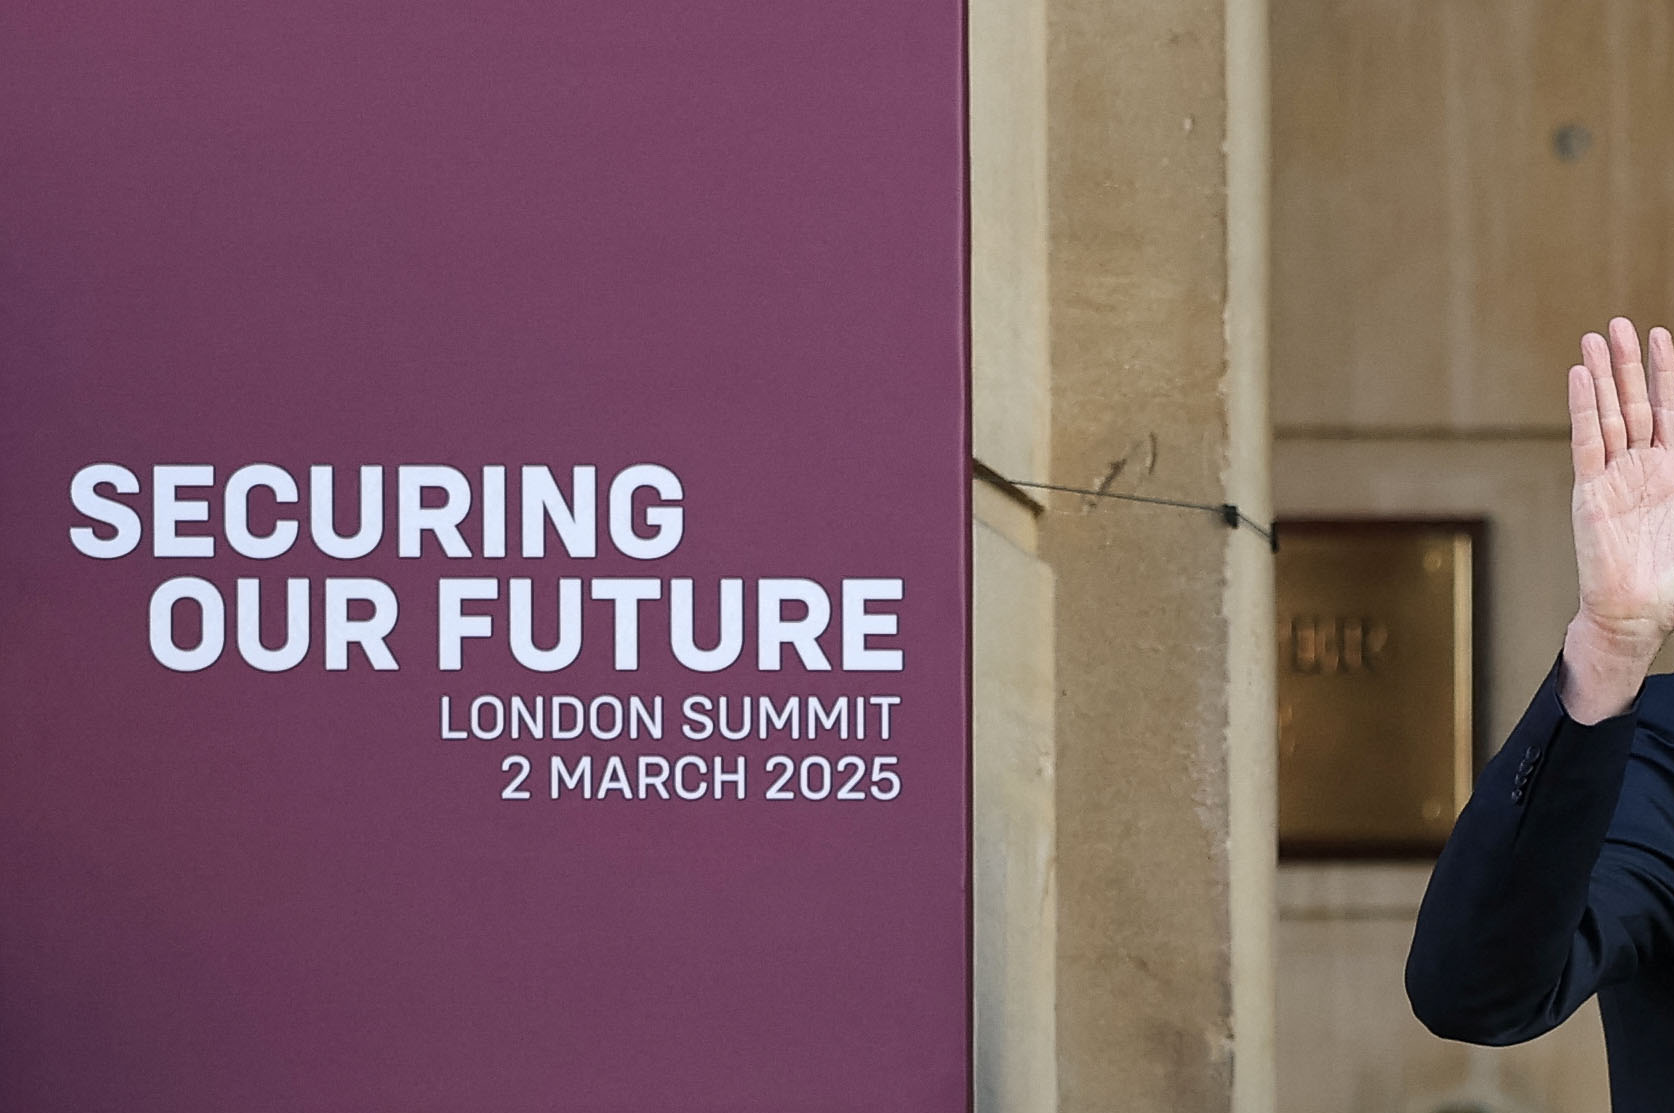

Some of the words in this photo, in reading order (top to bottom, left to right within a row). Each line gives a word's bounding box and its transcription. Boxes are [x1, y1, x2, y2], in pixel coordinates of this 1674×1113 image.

[69, 464, 684, 560] SECURING
[149, 576, 399, 672] OUR
[438, 577, 903, 672] FUTURE
[441, 695, 662, 740] LONDON
[682, 695, 901, 740] SUMMIT
[501, 755, 531, 801] 2
[550, 755, 745, 801] MARCH
[765, 755, 901, 801] 2025
